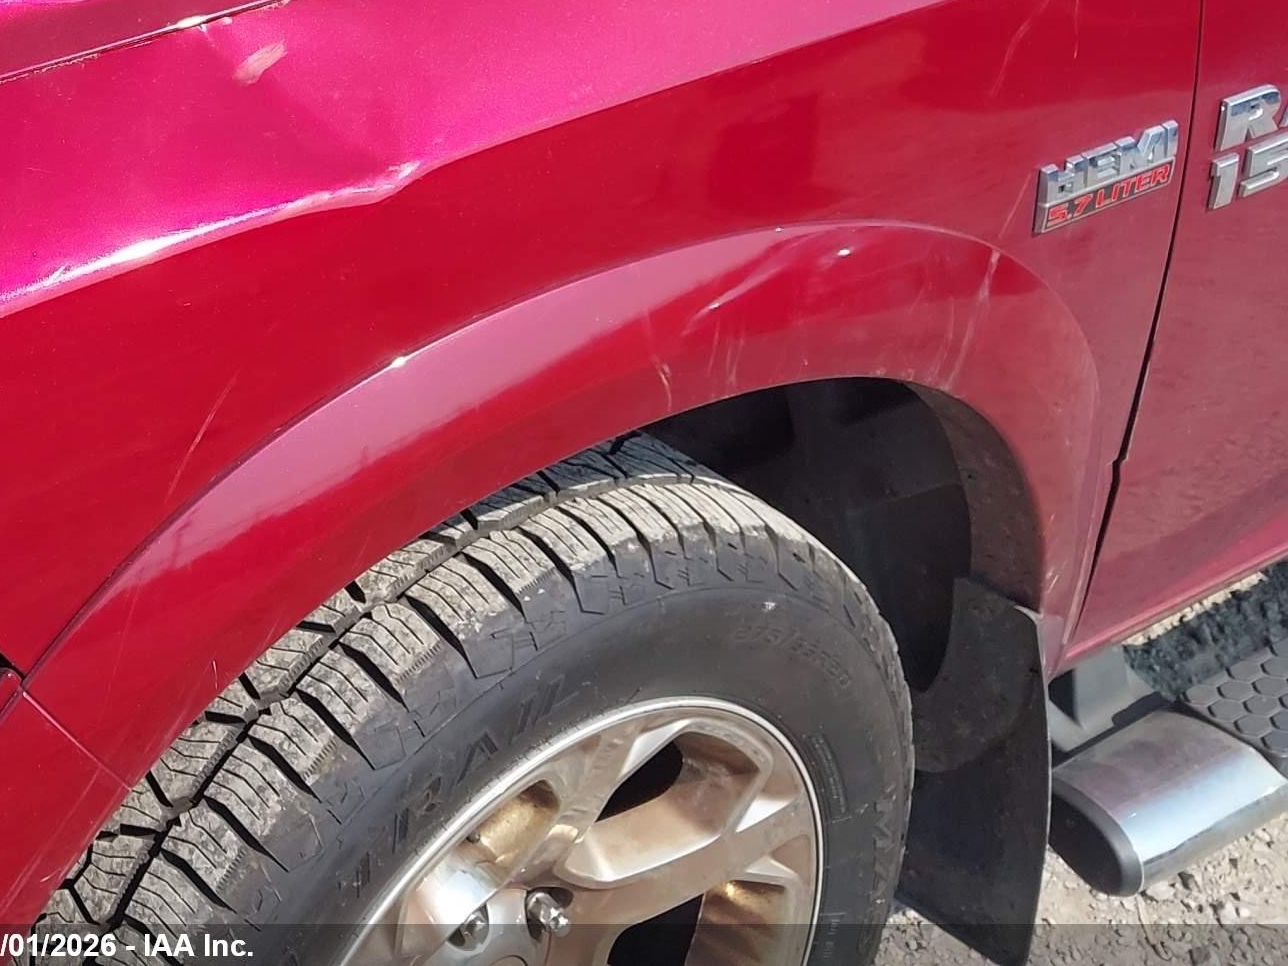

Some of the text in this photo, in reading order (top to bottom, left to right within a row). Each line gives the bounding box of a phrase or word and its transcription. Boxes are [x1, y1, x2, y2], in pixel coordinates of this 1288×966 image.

[1214, 84, 1288, 152] R
[1037, 119, 1179, 205] HEMI
[1046, 163, 1172, 226] 5.7 LITER
